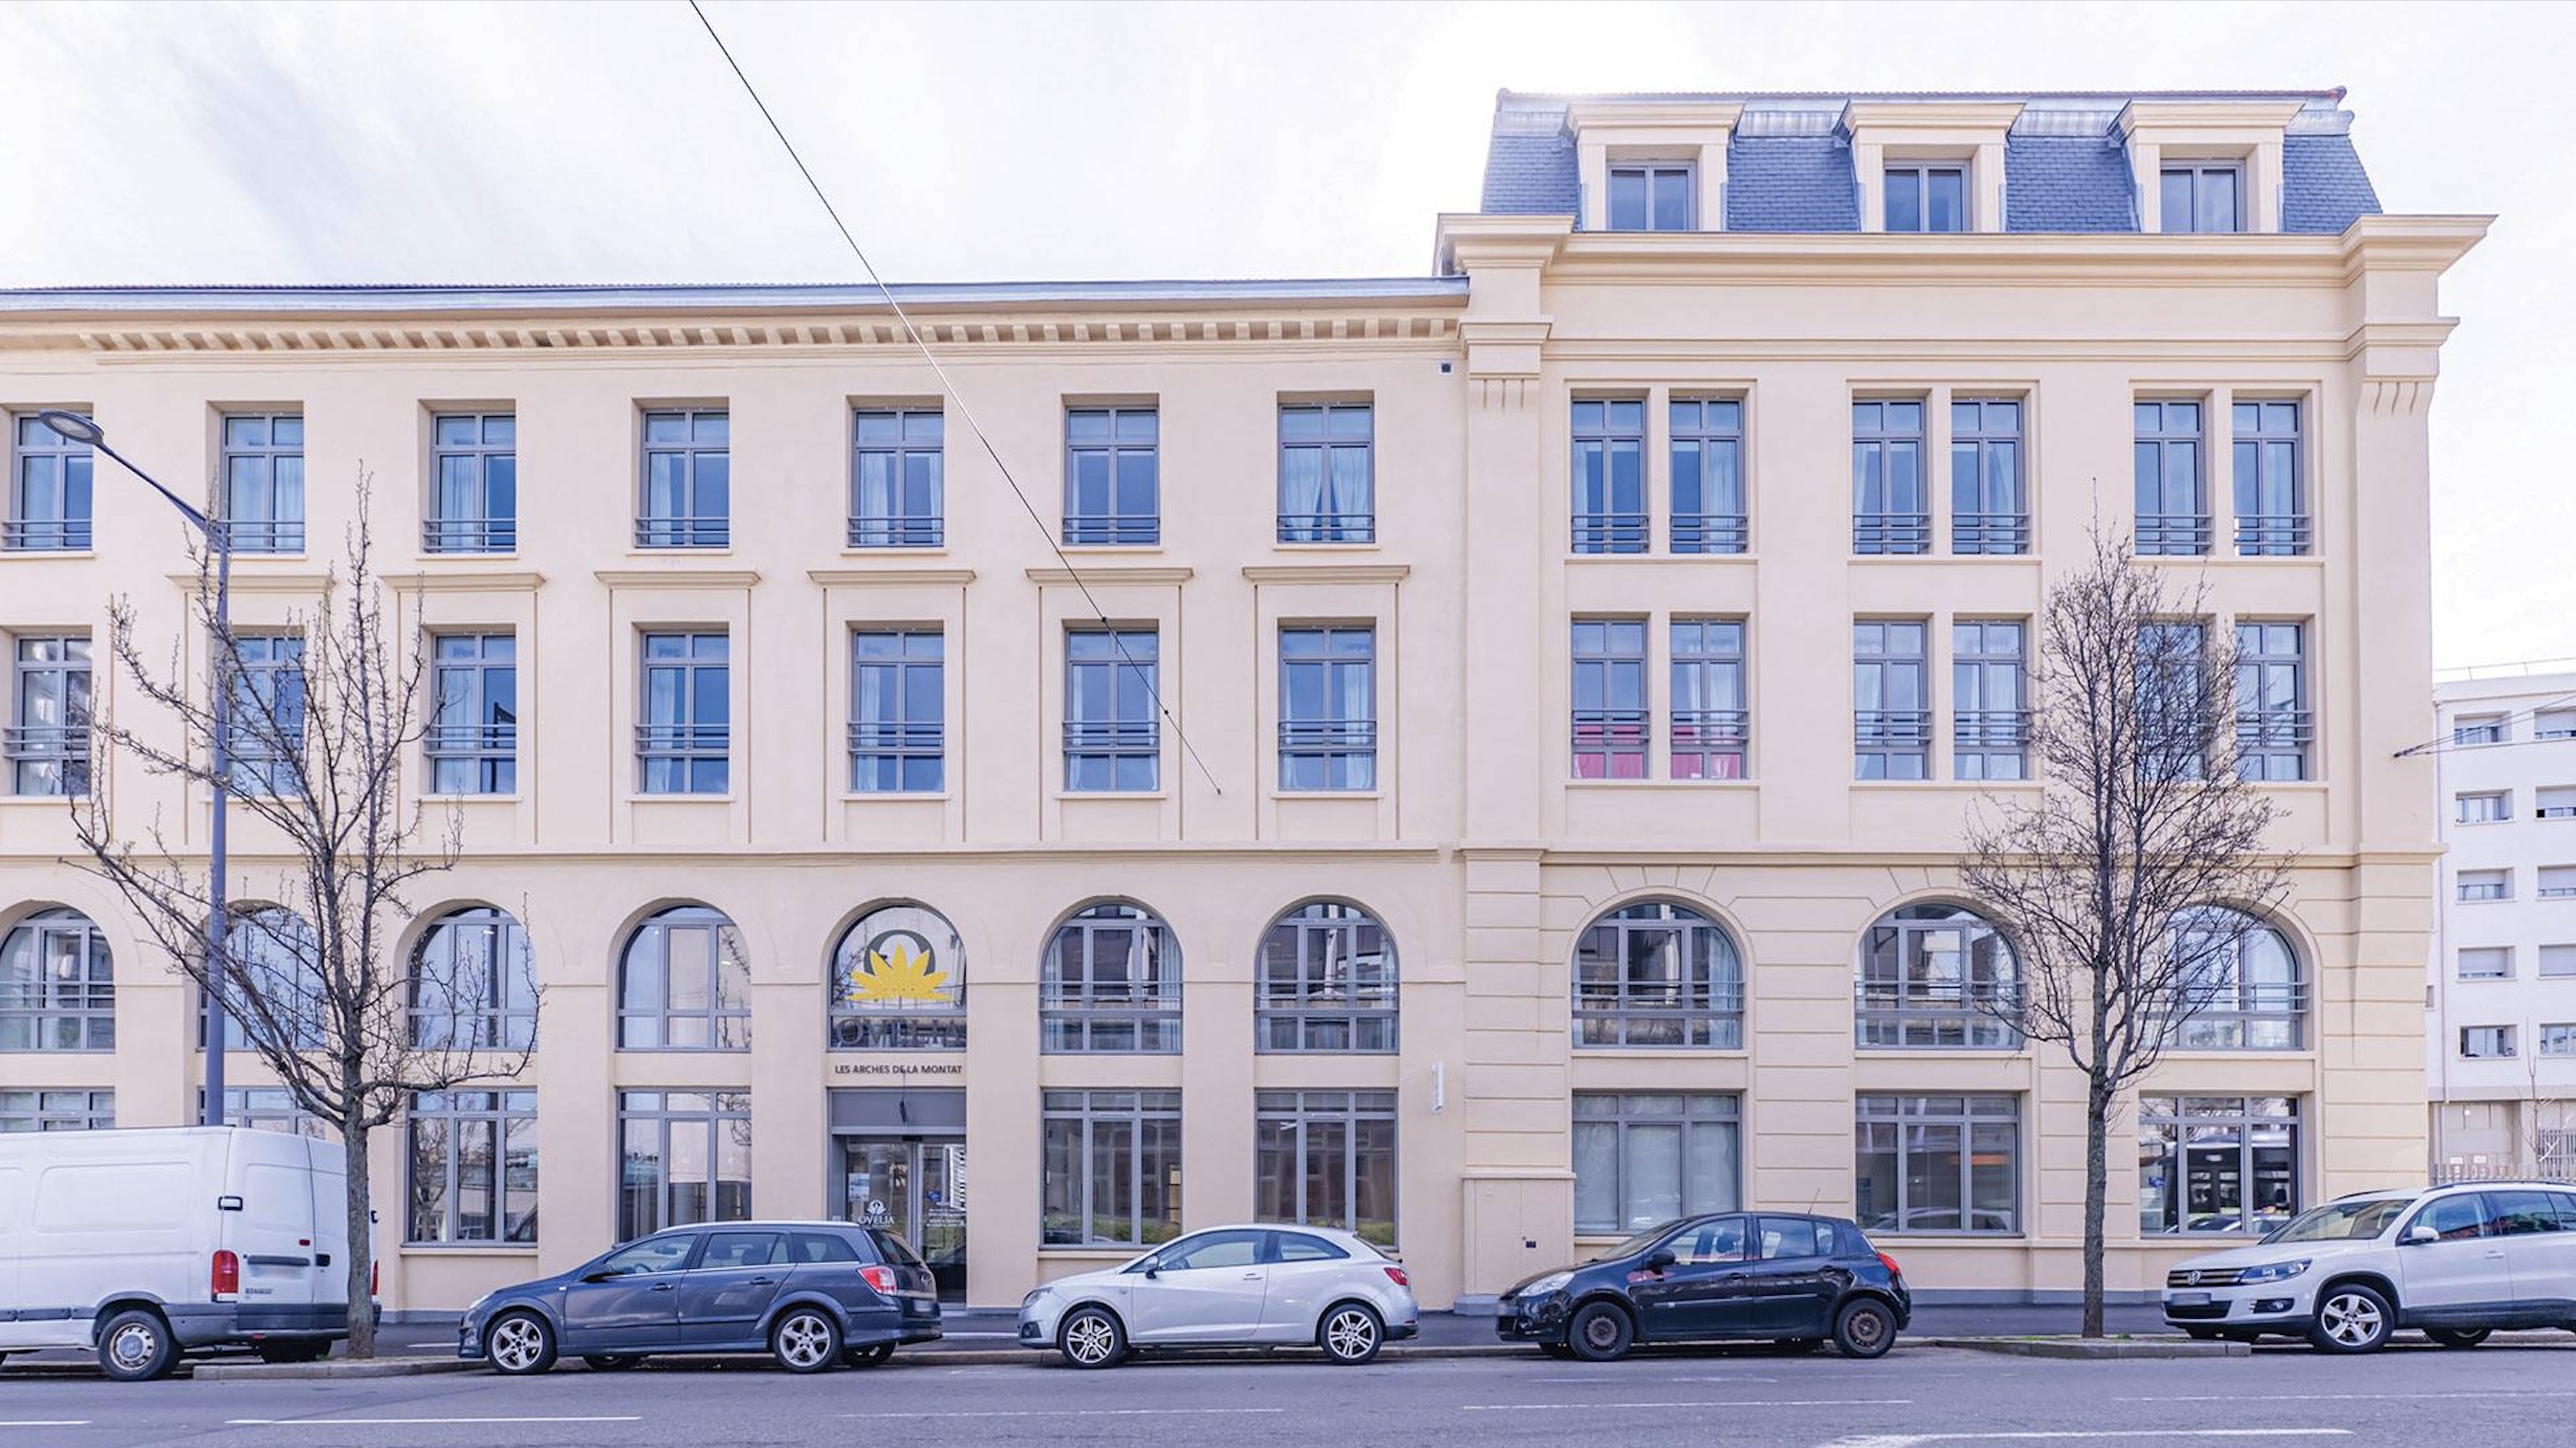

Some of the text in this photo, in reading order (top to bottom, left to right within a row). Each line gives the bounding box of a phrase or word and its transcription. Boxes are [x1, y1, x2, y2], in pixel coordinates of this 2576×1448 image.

[835, 1064, 962, 1074] LES ARCHES DE LA MONTAT
[858, 1215, 895, 1225] OVELIA
